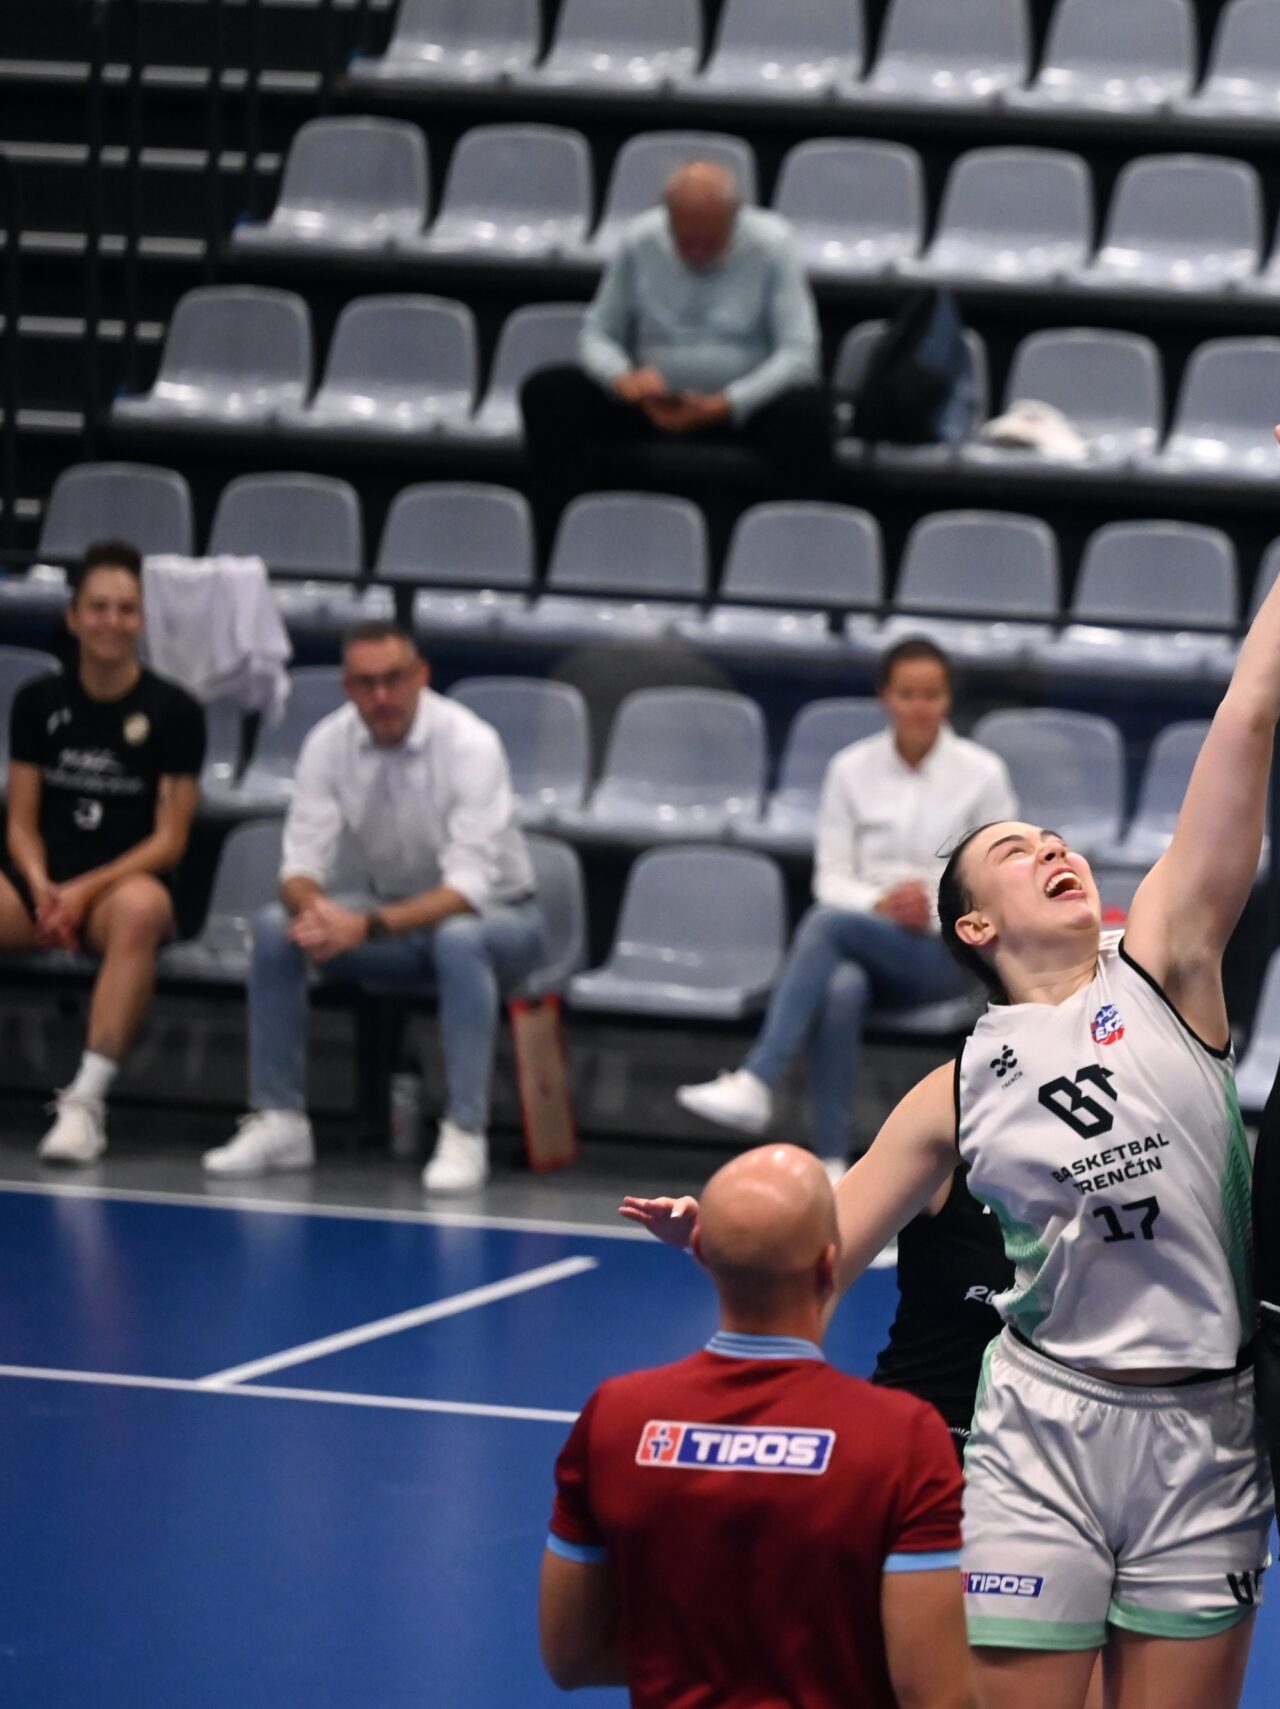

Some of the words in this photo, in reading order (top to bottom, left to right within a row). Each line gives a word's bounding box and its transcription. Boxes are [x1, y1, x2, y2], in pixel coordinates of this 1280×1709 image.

[1051, 1133, 1169, 1184] BASKETBAL
[1092, 1195, 1160, 1243] 17
[691, 1431, 821, 1467] TIPOS
[970, 1574, 1037, 1595] TIPOS
